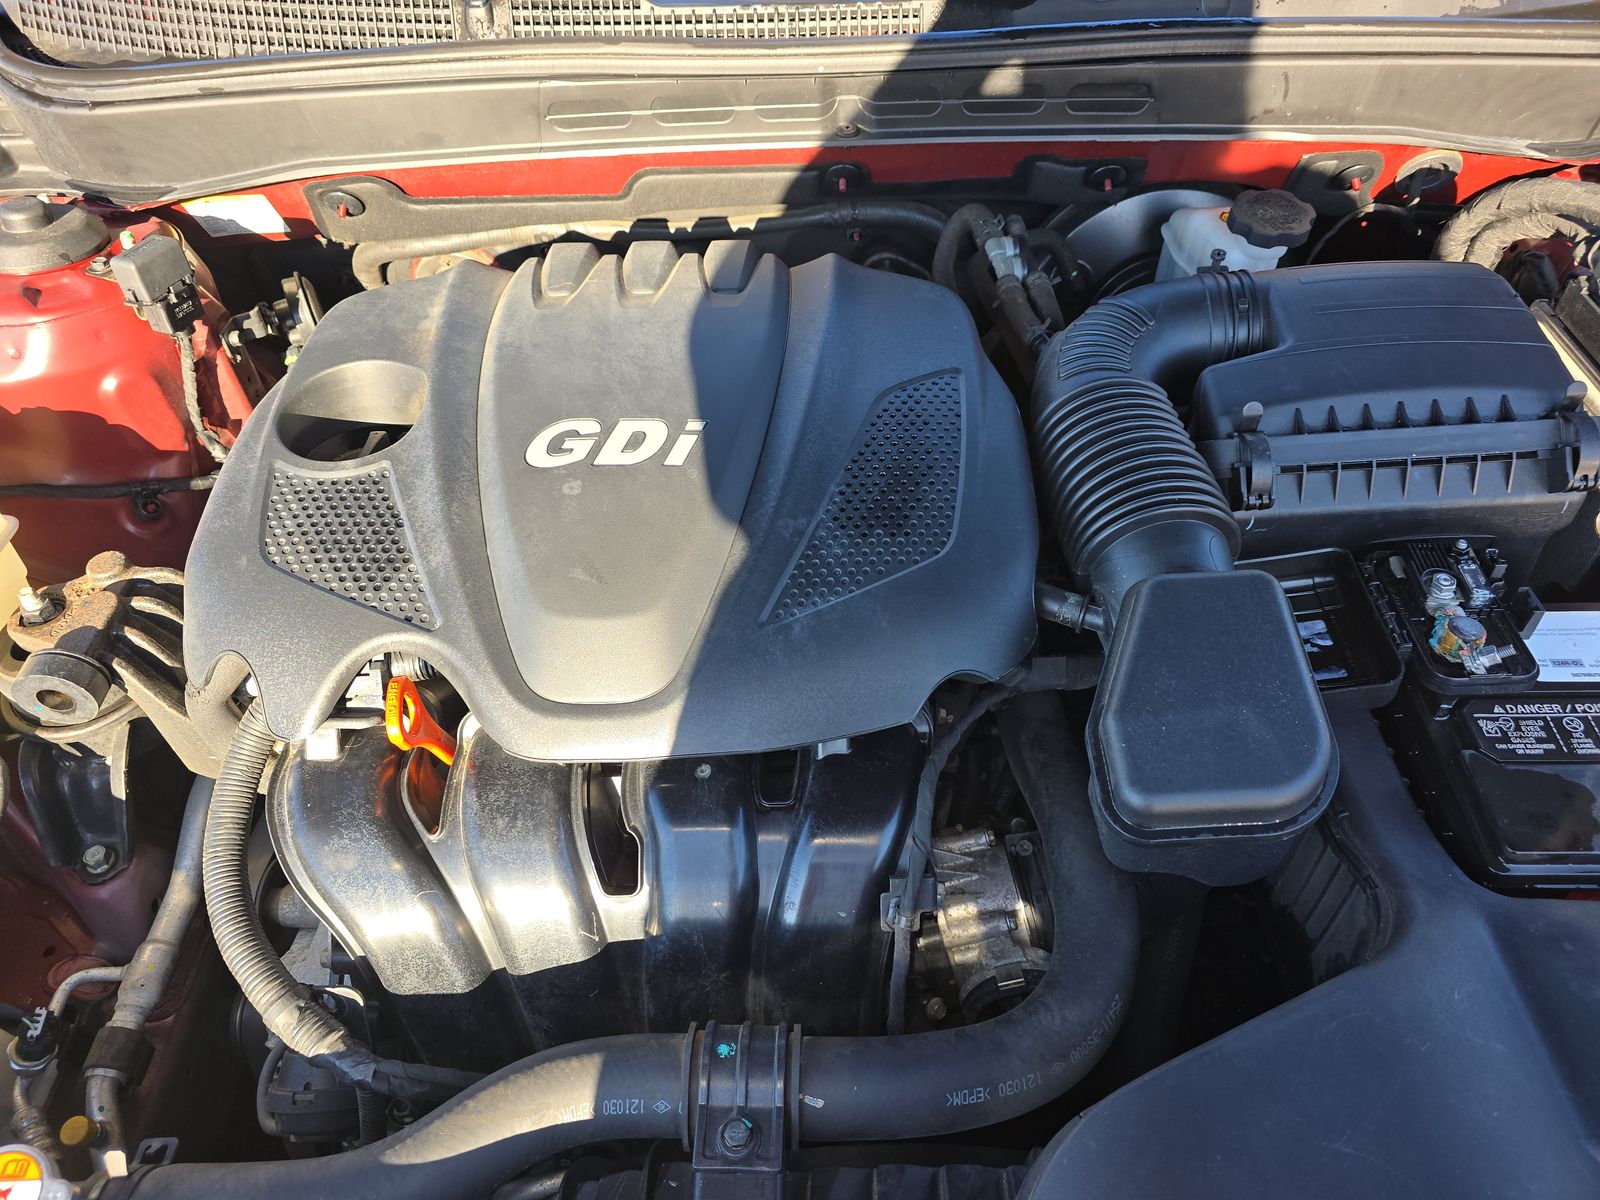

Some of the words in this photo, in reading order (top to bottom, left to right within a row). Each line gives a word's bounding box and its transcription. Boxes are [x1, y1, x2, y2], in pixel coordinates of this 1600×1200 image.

[524, 418, 709, 468] GDi
[1505, 704, 1563, 714] DANGER
[998, 1071, 1042, 1097] 121030
[602, 1098, 645, 1116] 121030
